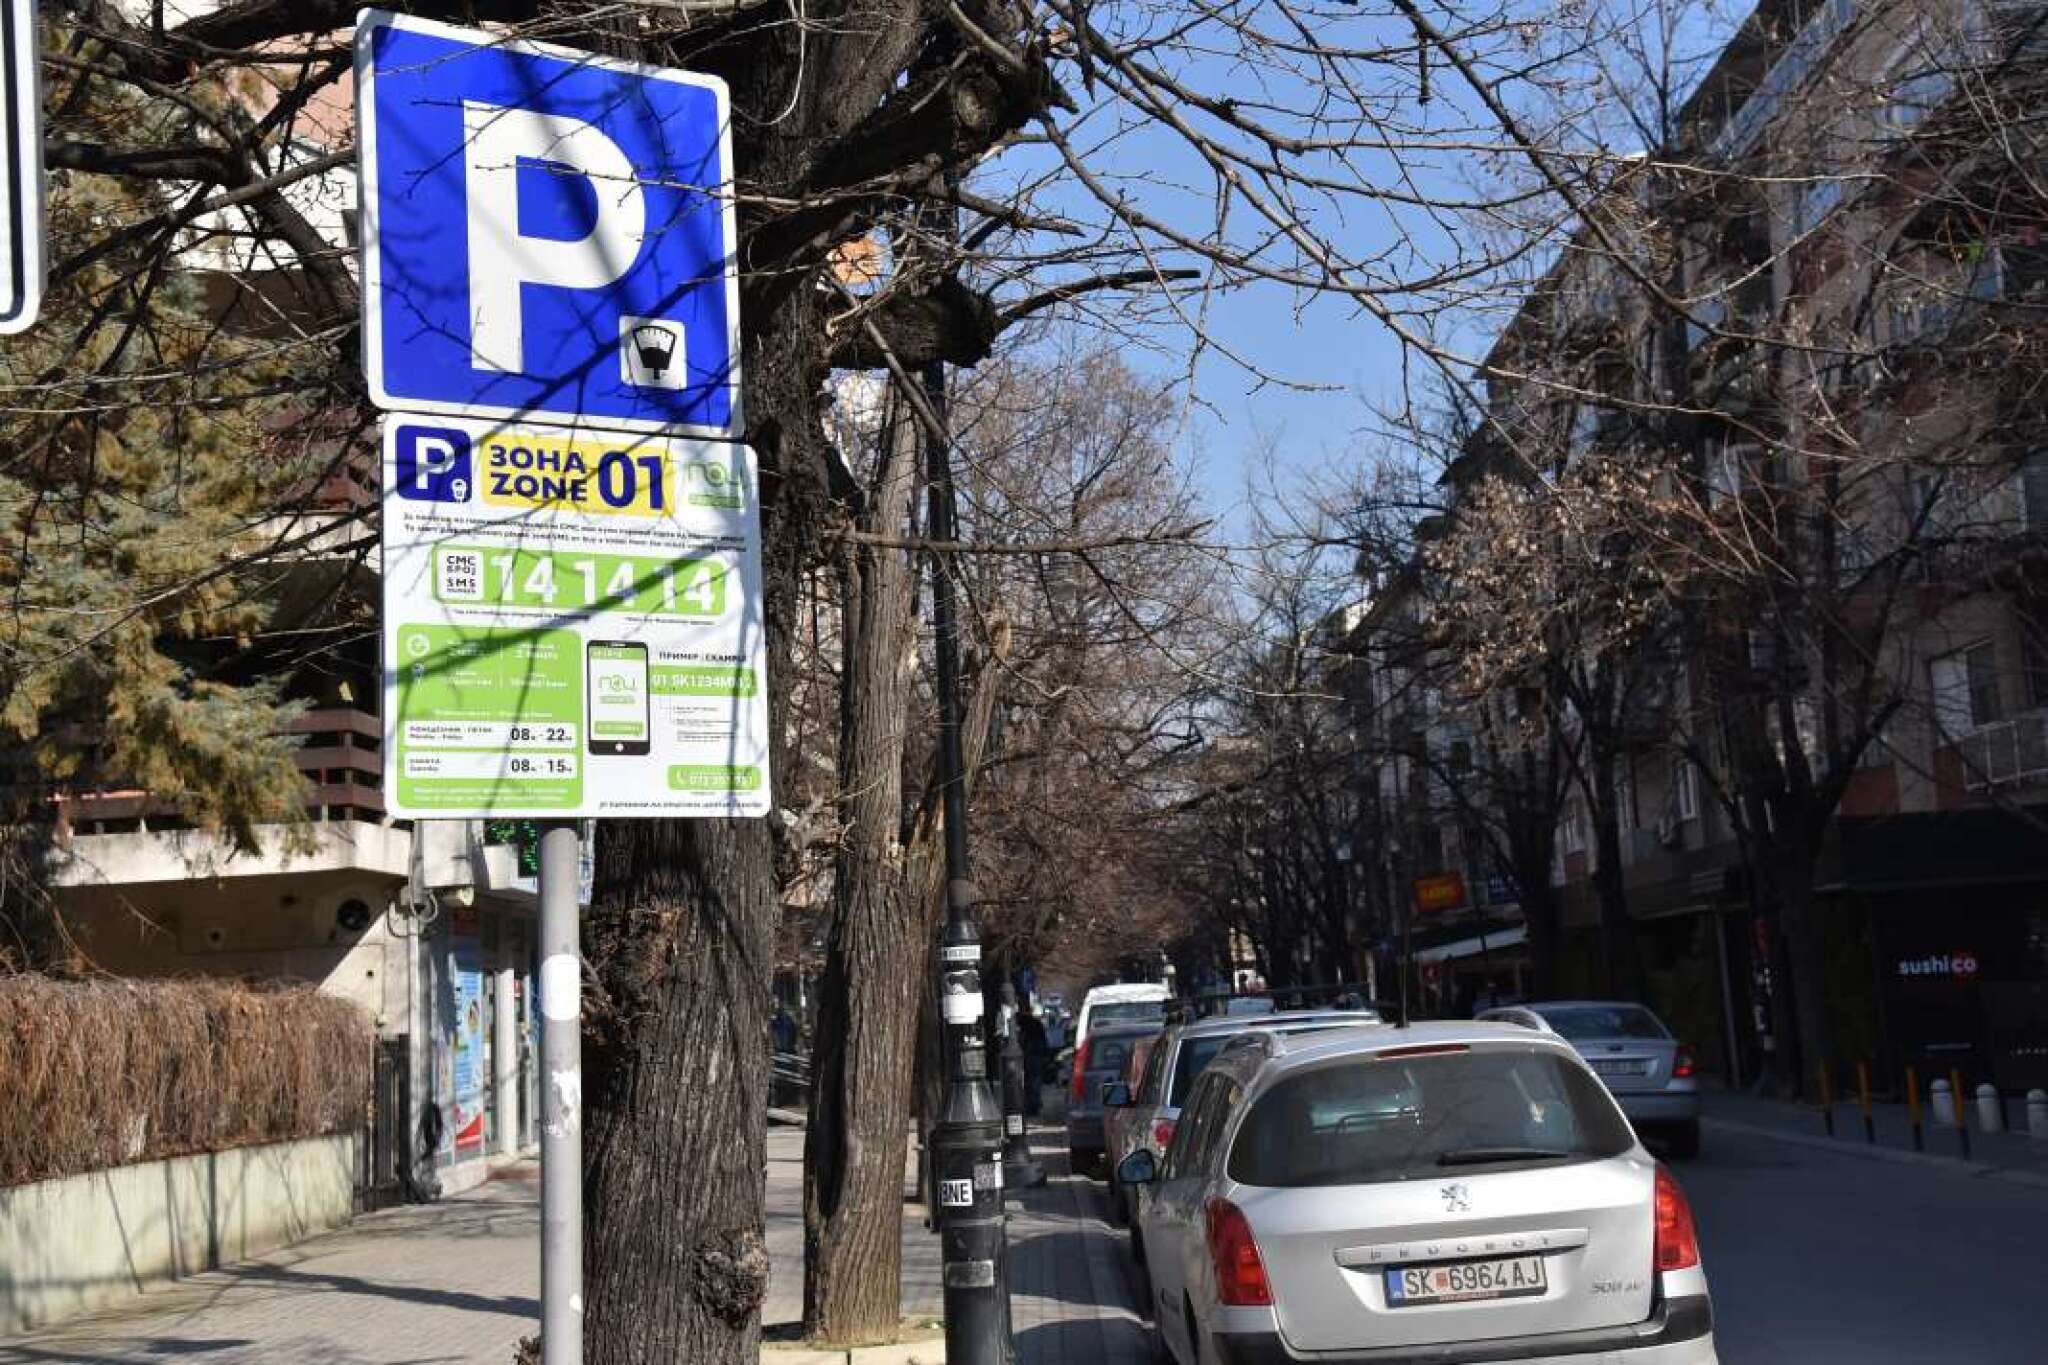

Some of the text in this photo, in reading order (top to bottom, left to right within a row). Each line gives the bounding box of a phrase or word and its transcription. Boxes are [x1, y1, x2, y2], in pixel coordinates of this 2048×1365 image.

[463, 99, 646, 374] P
[416, 437, 456, 491] P
[490, 444, 588, 474] ЗОНА
[490, 472, 588, 502] ZONE
[598, 450, 665, 510] 01
[490, 554, 715, 612] 14 14 14
